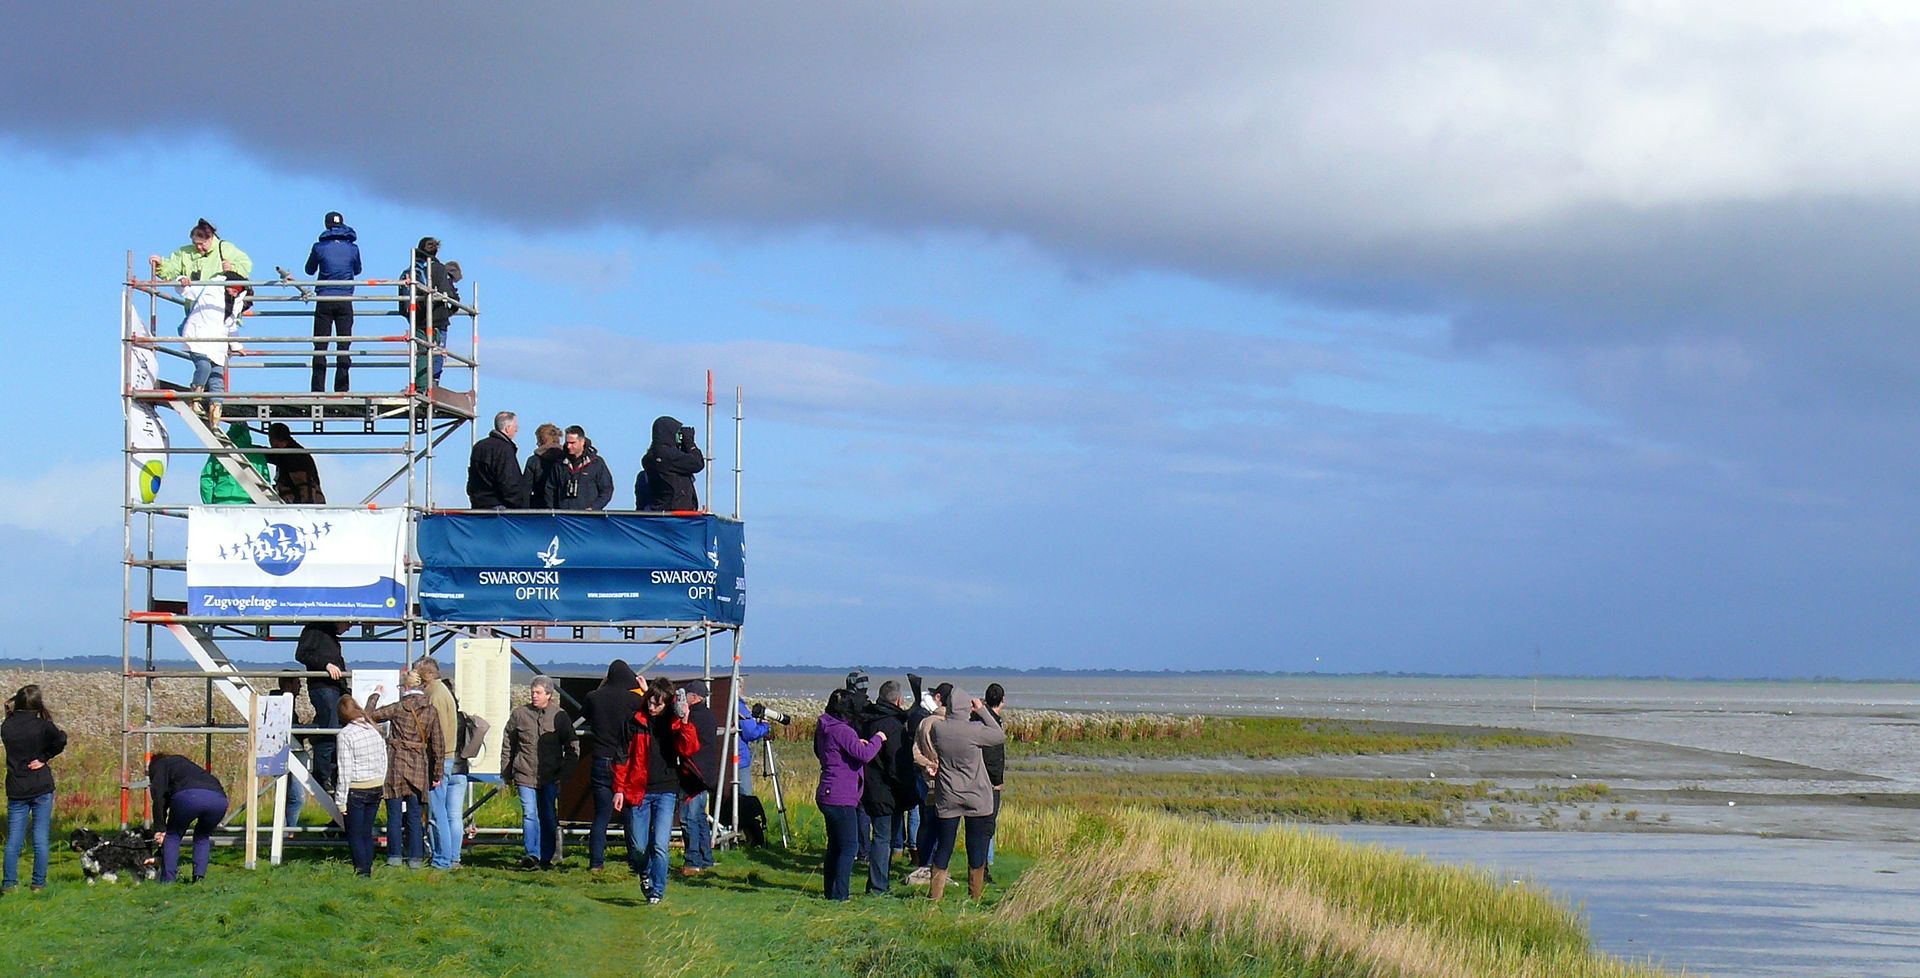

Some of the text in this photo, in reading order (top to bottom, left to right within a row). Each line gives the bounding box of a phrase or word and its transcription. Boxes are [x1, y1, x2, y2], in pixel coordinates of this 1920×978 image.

[479, 571, 559, 585] SWAROVSKI
[515, 586, 560, 600] OPTIK
[203, 595, 278, 611] Zugvogeltage
